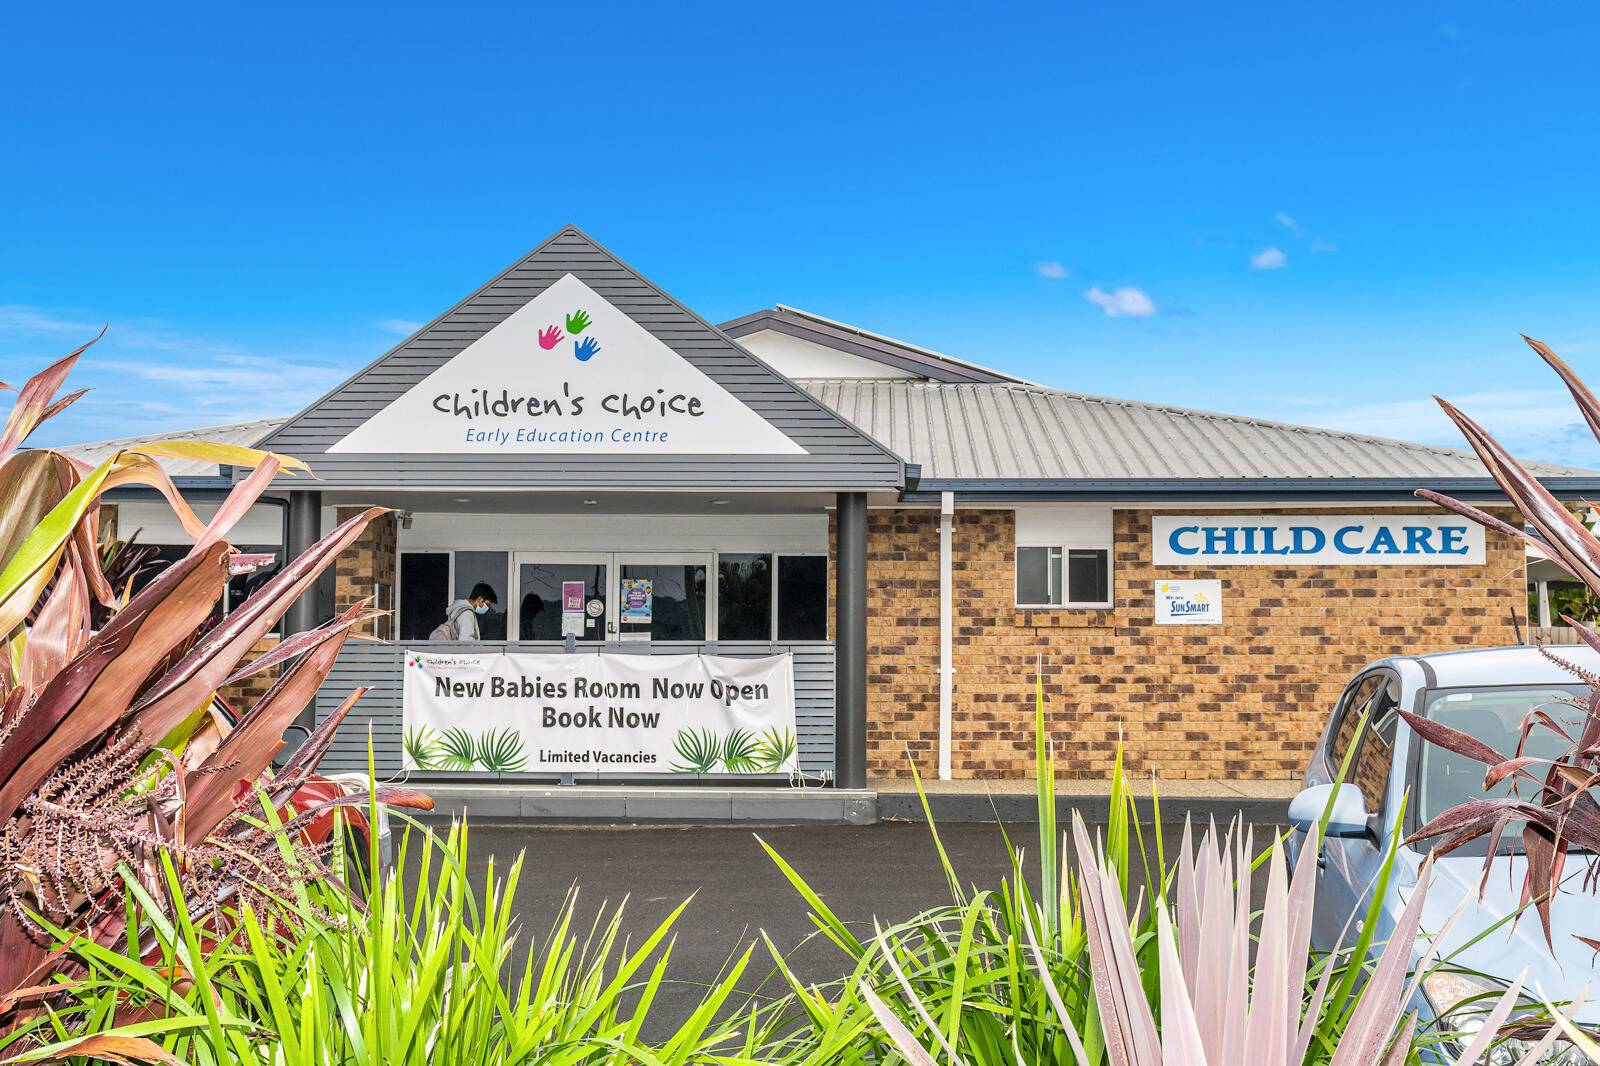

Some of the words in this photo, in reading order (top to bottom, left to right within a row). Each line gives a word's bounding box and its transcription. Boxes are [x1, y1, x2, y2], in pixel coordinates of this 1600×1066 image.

[466, 428, 510, 446] Early
[516, 428, 604, 443] Education
[611, 428, 669, 443] Centre
[1168, 525, 1327, 556] CHILD
[1333, 525, 1470, 556] CARE
[435, 676, 485, 698] New
[491, 676, 568, 699] Babies
[574, 677, 641, 699] Room
[652, 677, 705, 699] Now
[710, 679, 769, 707] Open
[542, 706, 603, 728] Book
[608, 706, 661, 728] Now
[539, 749, 590, 763] Limited
[592, 750, 657, 764] Vacancies
